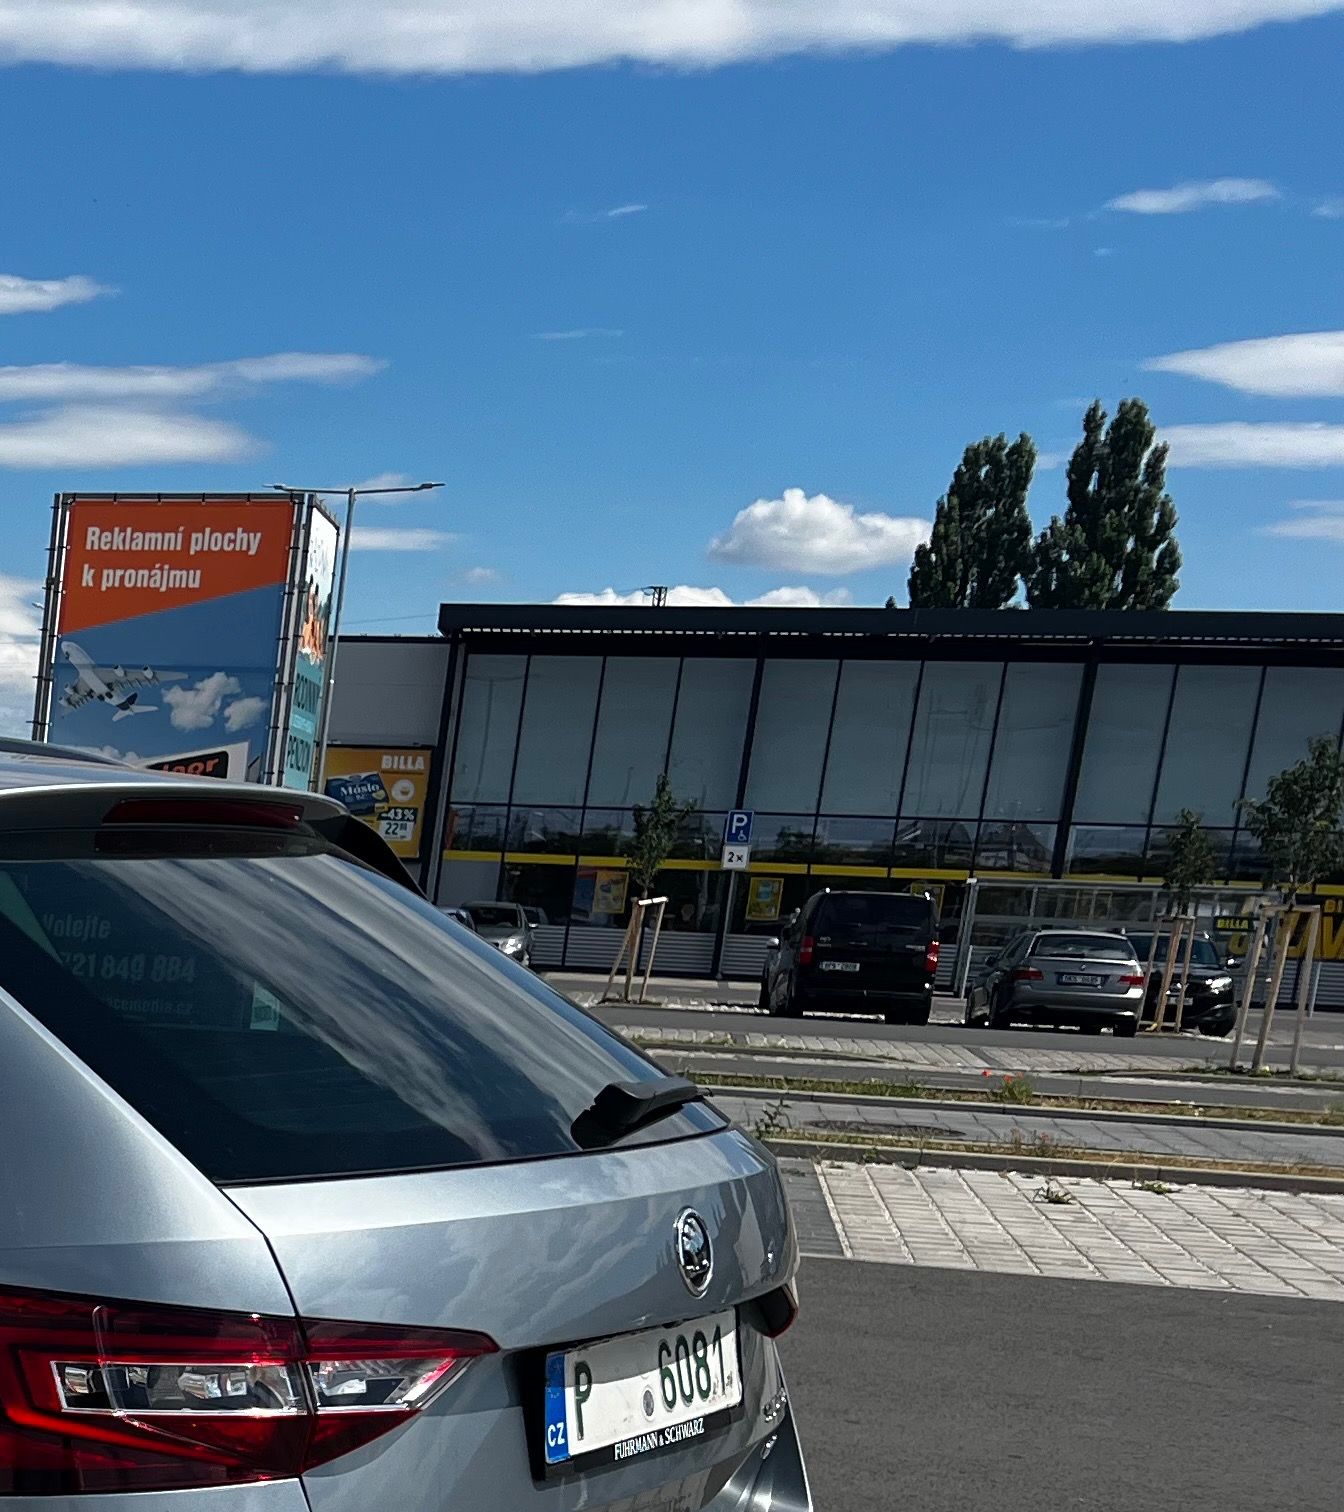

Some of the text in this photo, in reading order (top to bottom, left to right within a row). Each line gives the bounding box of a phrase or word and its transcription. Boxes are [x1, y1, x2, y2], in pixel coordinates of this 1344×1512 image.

[85, 526, 262, 556] Reklamní plochy
[81, 562, 201, 592] k pronájmu
[381, 754, 425, 770] BILLA
[731, 813, 748, 834] P
[43, 913, 112, 942] Volejte
[573, 1360, 593, 1442] P
[658, 1324, 726, 1413] 6081
[547, 1421, 565, 1448] CZ
[614, 1431, 659, 1461] FUHRMANN
[664, 1417, 705, 1446] SCHWARZ
